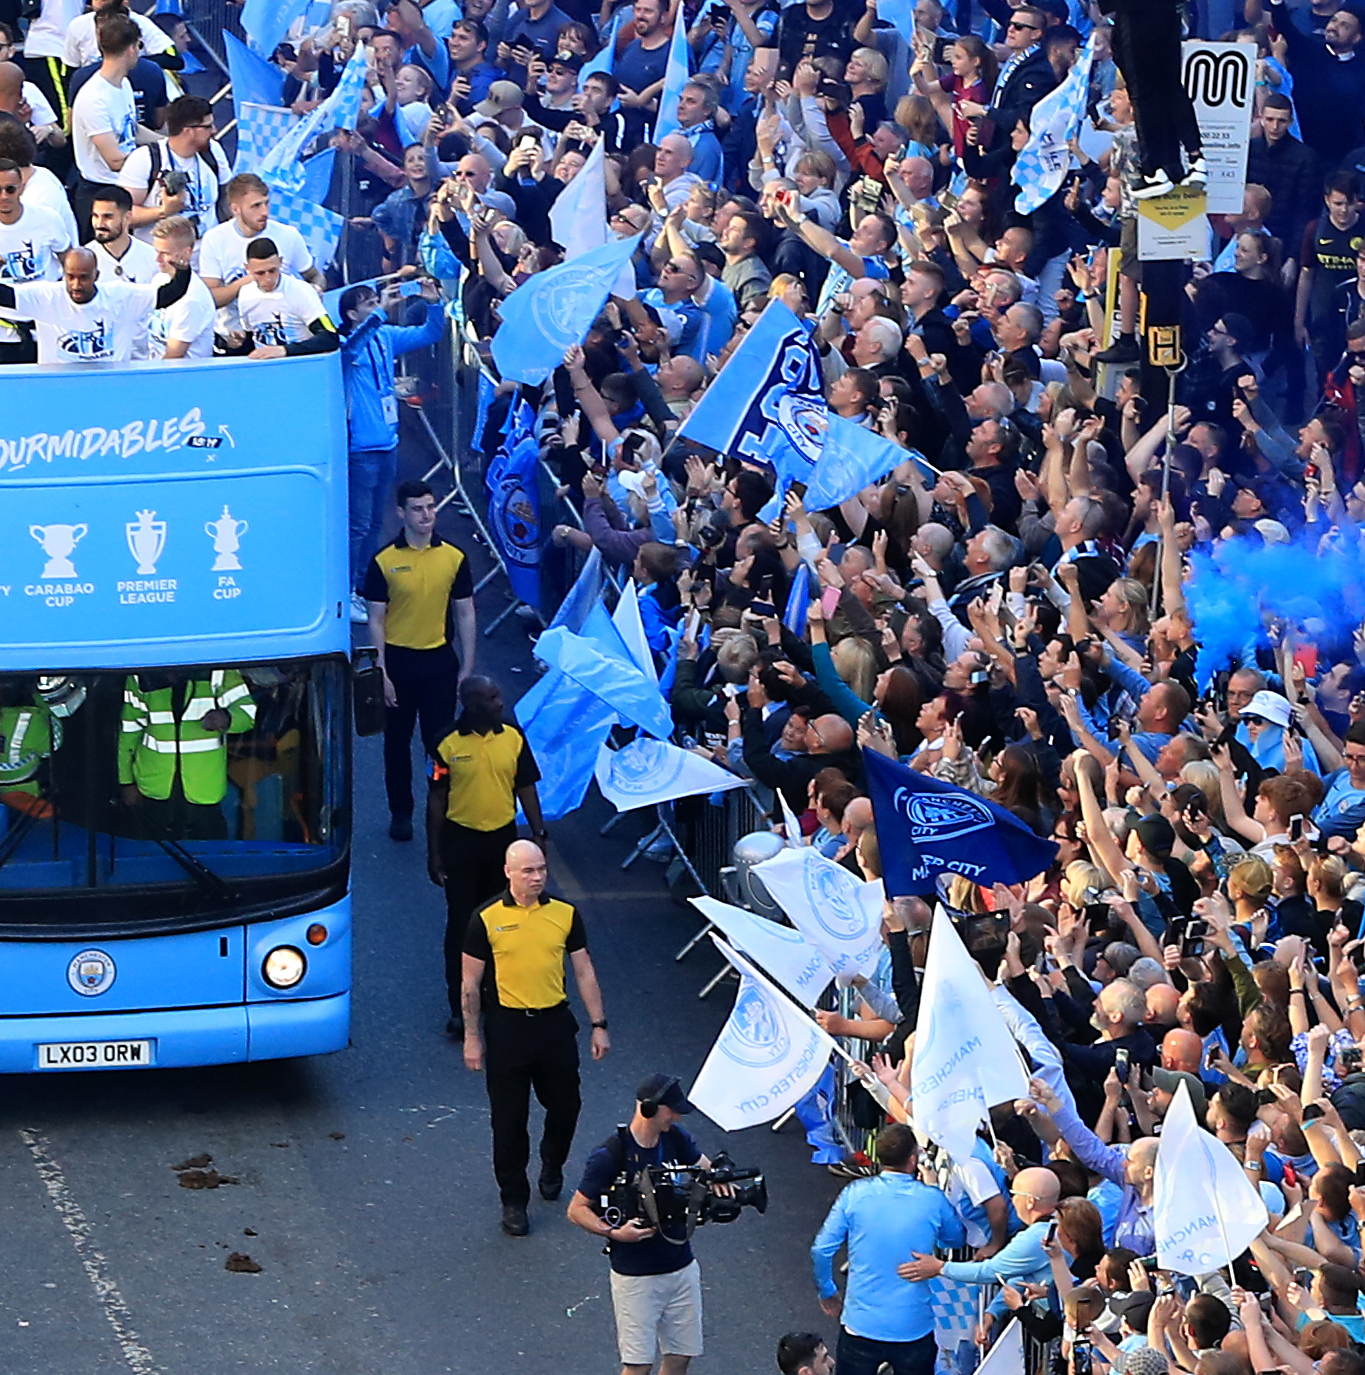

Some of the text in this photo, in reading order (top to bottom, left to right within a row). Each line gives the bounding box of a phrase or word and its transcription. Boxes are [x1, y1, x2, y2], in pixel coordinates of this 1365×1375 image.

[786, 422, 808, 449] CITY
[117, 578, 178, 592] PREMIER
[218, 576, 236, 588] FA
[24, 583, 95, 597] CARABAO
[213, 587, 242, 600] CUP
[45, 595, 74, 607] CUP
[119, 591, 175, 604] LEAGUE
[911, 825, 939, 836] CITY
[947, 860, 987, 877] CITY
[46, 1043, 142, 1064] LX03 ORW
